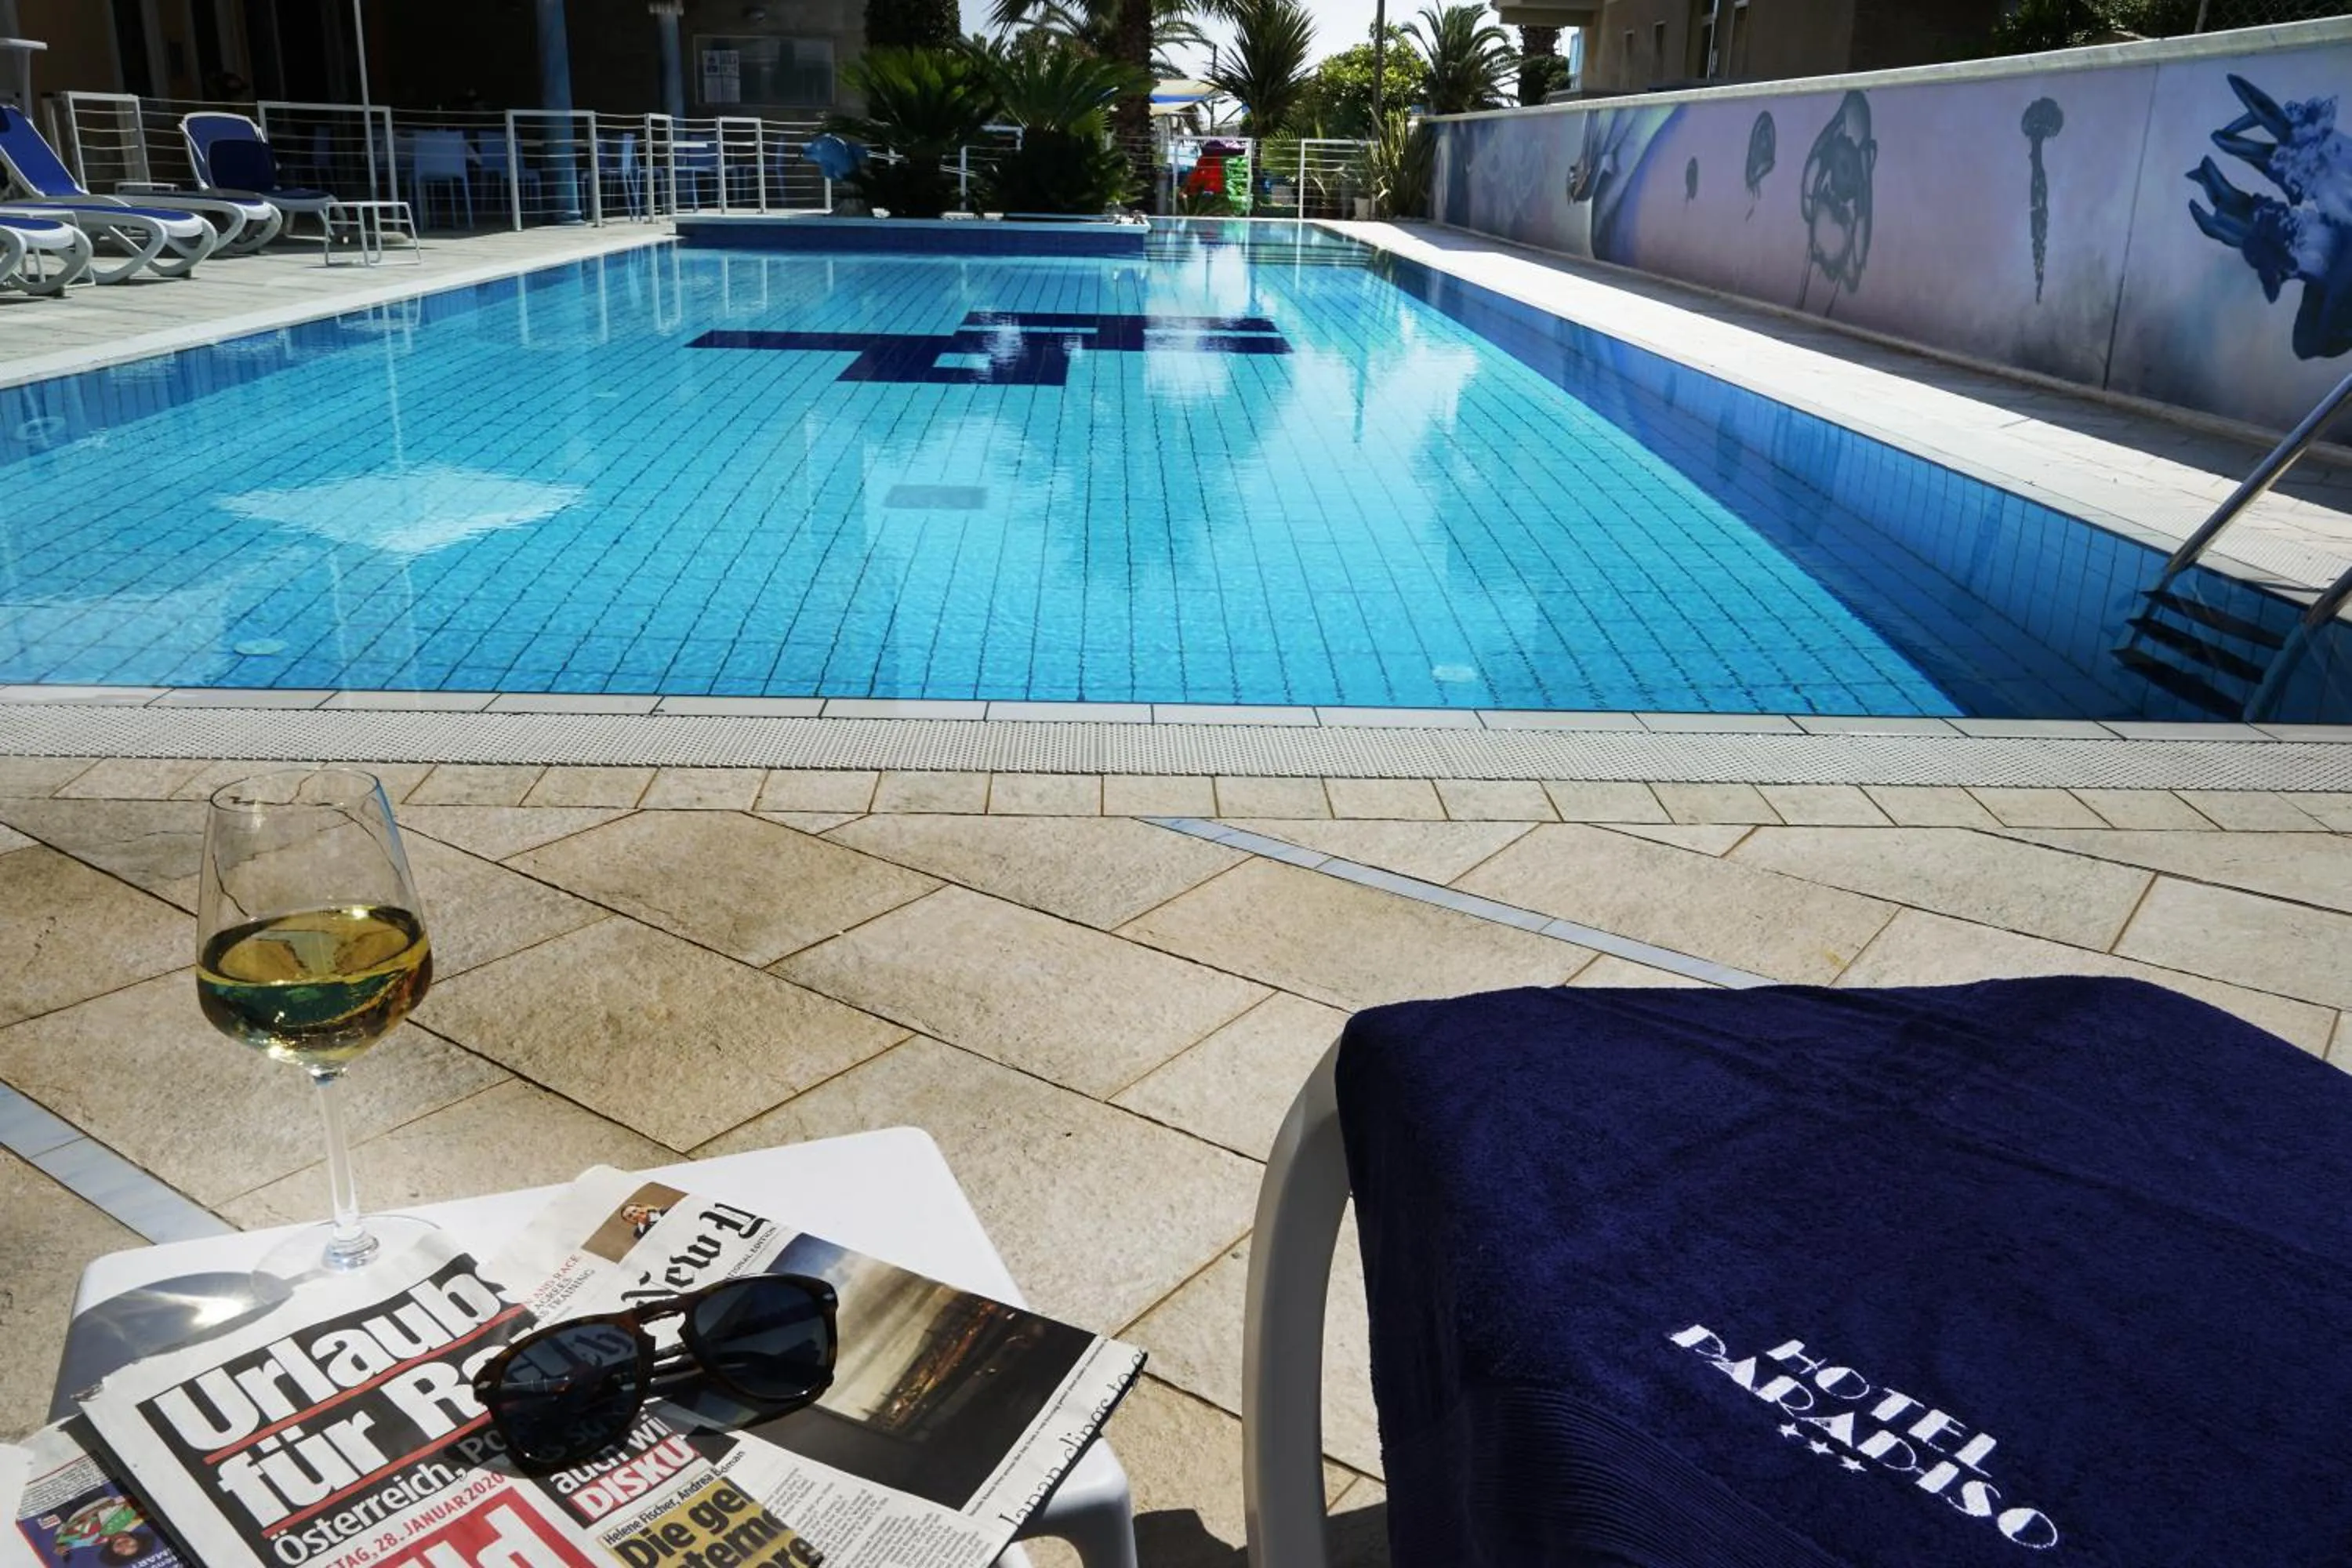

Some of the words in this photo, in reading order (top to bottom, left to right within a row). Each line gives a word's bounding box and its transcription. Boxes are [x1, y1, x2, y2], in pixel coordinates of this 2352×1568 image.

[154, 1271, 503, 1450] Urlaub
[1765, 1339, 1998, 1478] HOTEL
[216, 1406, 390, 1529] für
[1668, 1324, 2059, 1549] PARADISO
[270, 1463, 468, 1566] Österreich,
[373, 1532, 405, 1552] 28.
[403, 1494, 467, 1536] JANUAR
[464, 1471, 506, 1501] 2020
[604, 1520, 643, 1544] Helene
[639, 1497, 681, 1524] Fischer,
[677, 1472, 714, 1501] Andrea
[614, 1522, 697, 1568] Die
